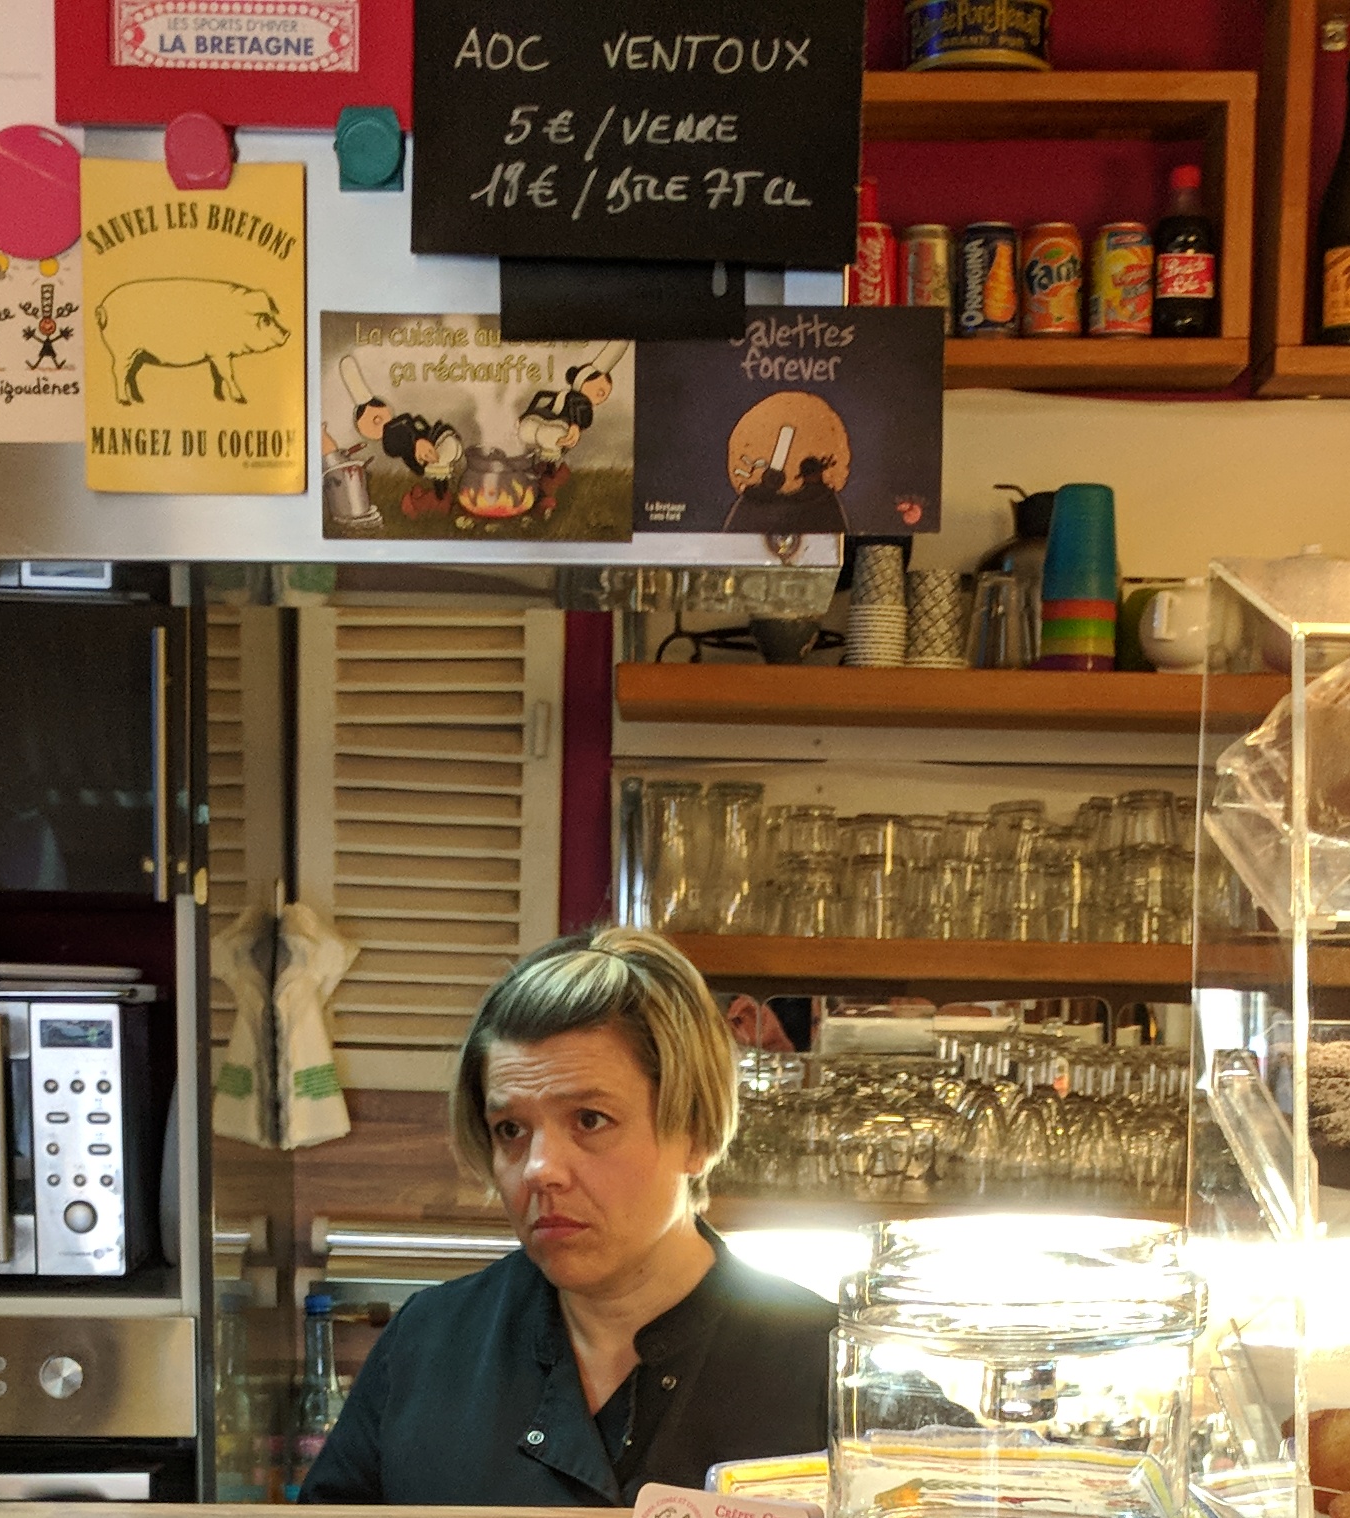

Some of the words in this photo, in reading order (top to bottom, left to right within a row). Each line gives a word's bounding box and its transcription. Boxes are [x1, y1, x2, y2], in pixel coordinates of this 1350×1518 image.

[167, 18, 188, 31] LES
[193, 18, 243, 32] SPORTS
[246, 19, 298, 33] D'HIVER
[158, 34, 182, 54] LA
[195, 35, 314, 57] BRETAGNE
[454, 27, 549, 71] AOC
[603, 32, 811, 74] VENTOUX
[85, 204, 159, 256] SAUVEZ
[165, 201, 199, 230] LES
[206, 202, 297, 261] BRETONS
[960, 238, 985, 327] ORANGINA
[355, 321, 383, 347] La
[388, 320, 469, 348] cuisine
[389, 363, 416, 388] ça
[422, 353, 542, 385] réchauffe
[741, 346, 842, 382] forever
[90, 426, 172, 457] MANGEZ
[182, 429, 207, 458] DU
